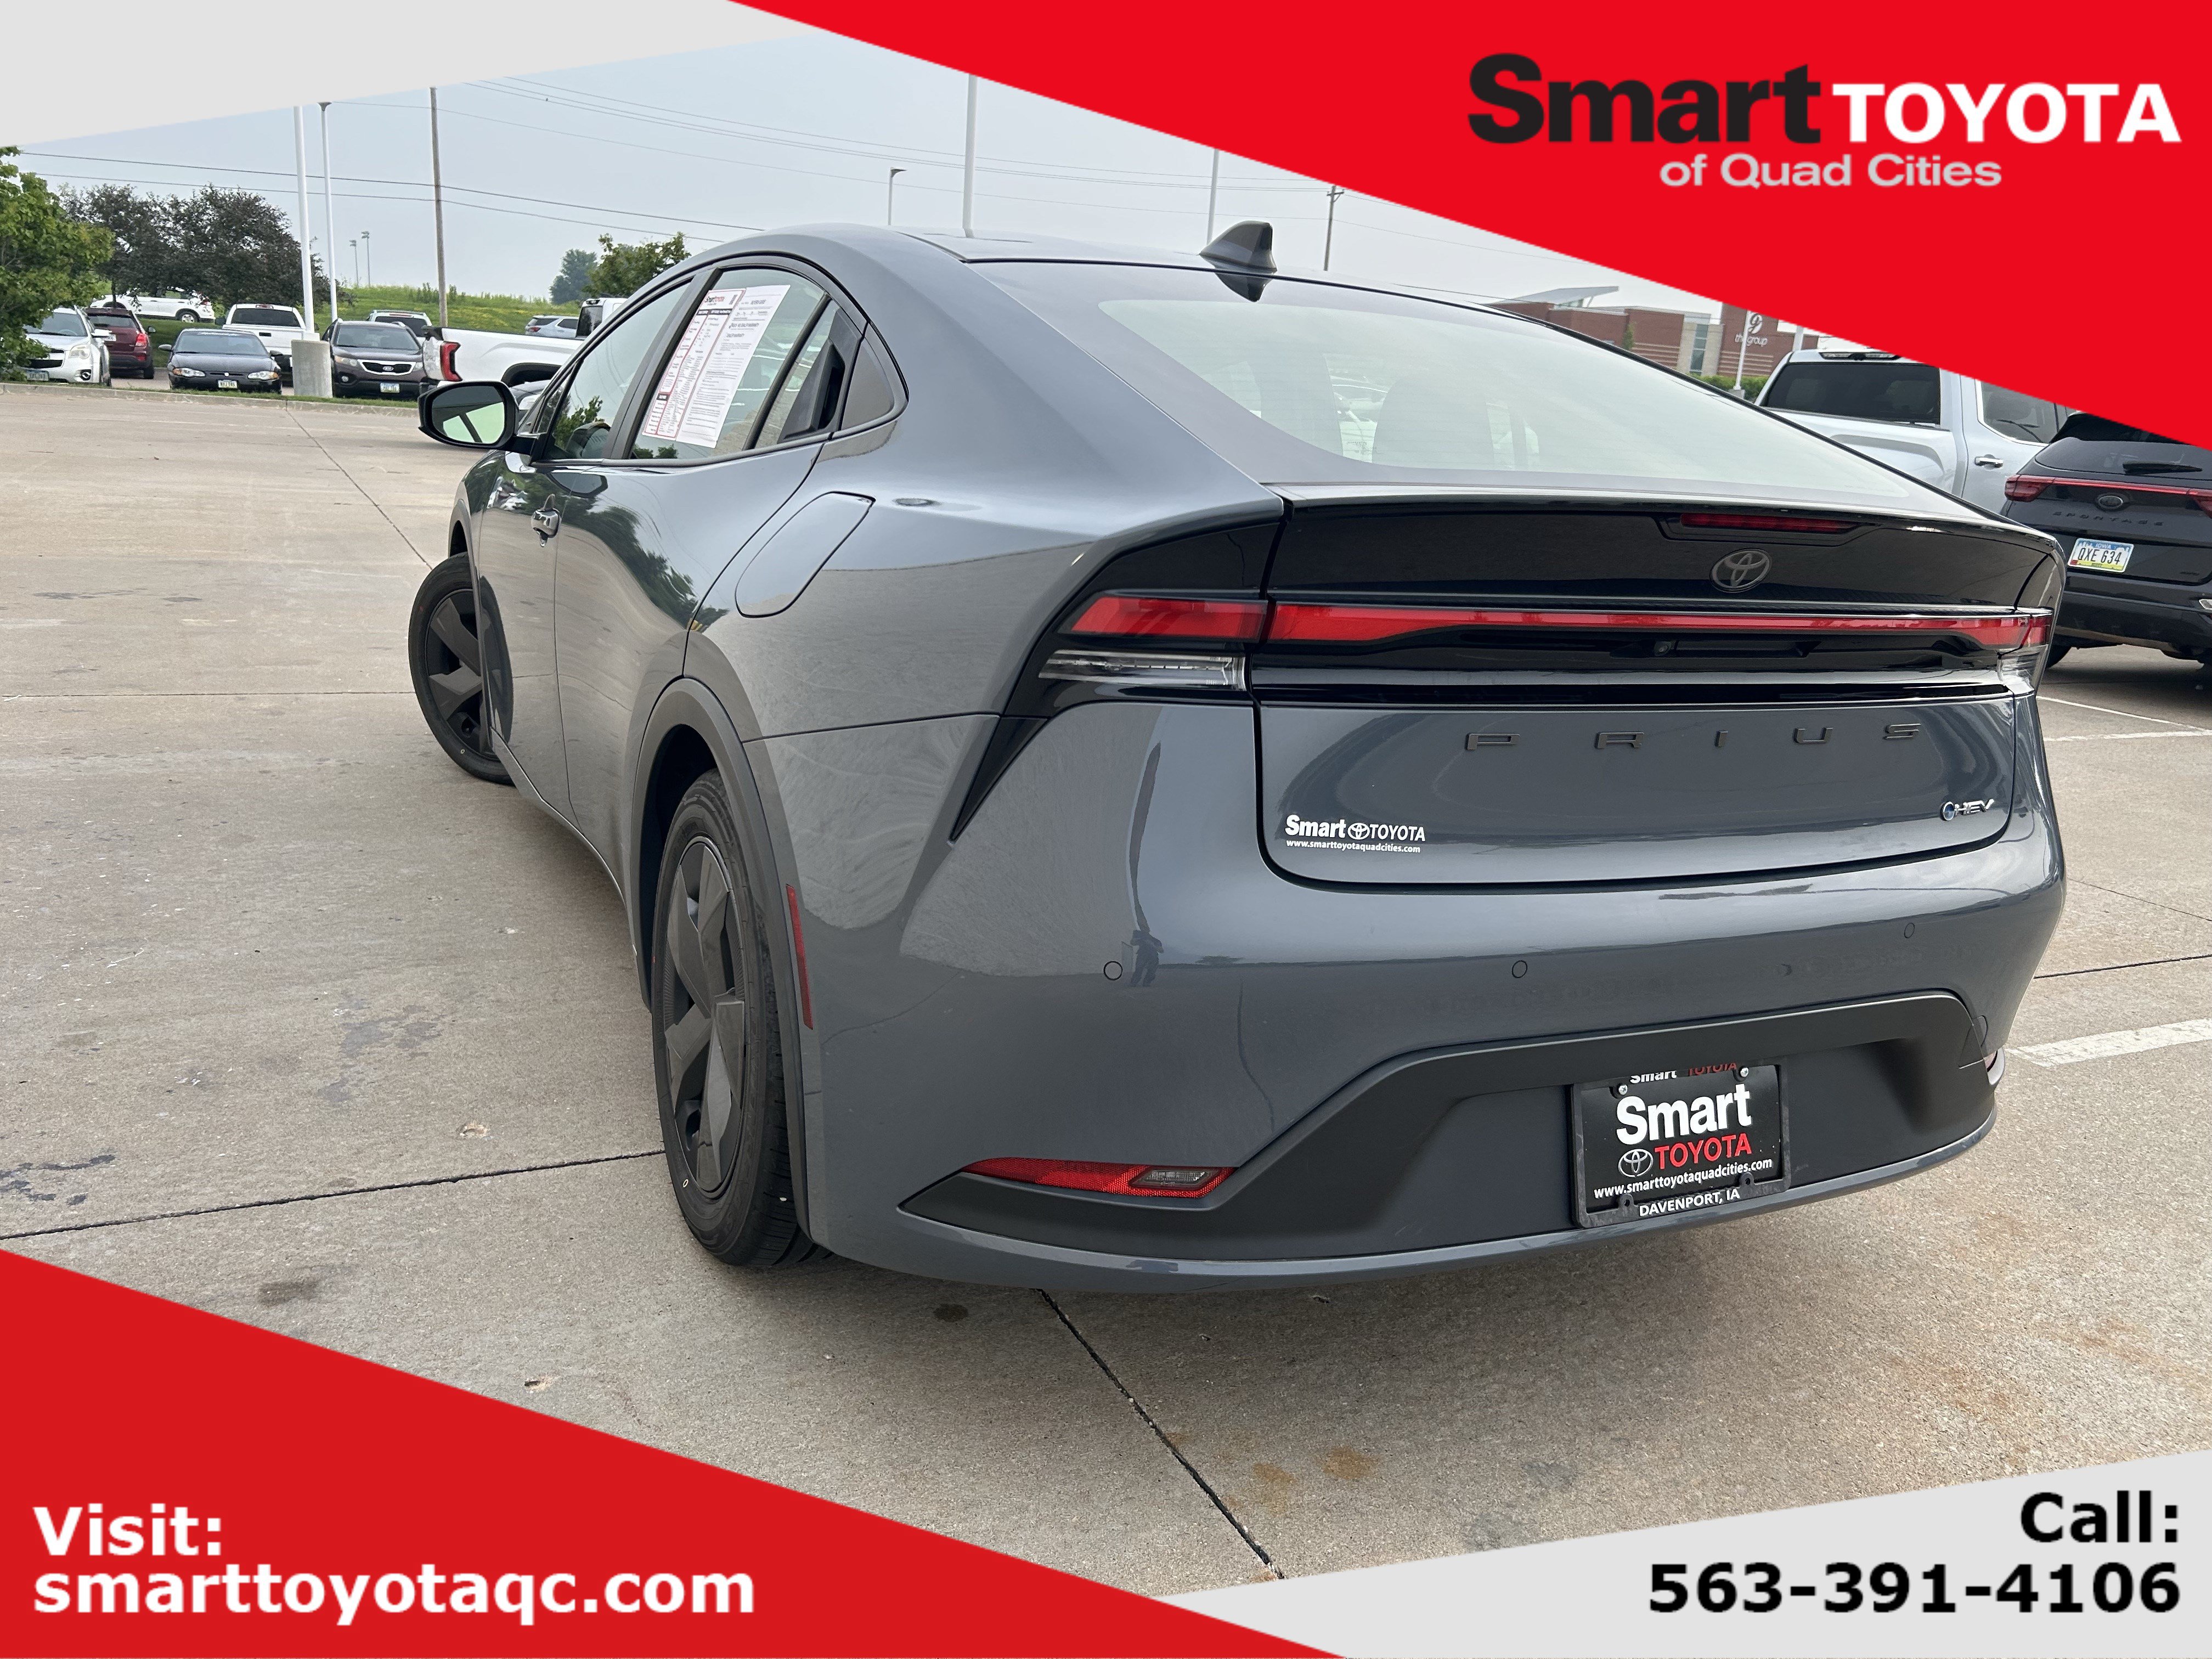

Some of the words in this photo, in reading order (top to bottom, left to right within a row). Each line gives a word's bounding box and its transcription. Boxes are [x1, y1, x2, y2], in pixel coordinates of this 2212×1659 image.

[2101, 550, 2122, 565] 634
[1465, 723, 1922, 751] PRIUS
[1285, 814, 1346, 838] Smart
[1369, 824, 1426, 842] TOYOTA
[1286, 840, 1421, 854] www.smarttoyotaquadcities.com
[1616, 1084, 1752, 1145] Smart
[1654, 1132, 1752, 1170] TOYOTA
[1594, 1158, 1773, 1199] www.smarttoyotaquadcities.com
[1639, 1192, 1724, 1217] DAVENPORT,
[1726, 1188, 1740, 1201] IA
